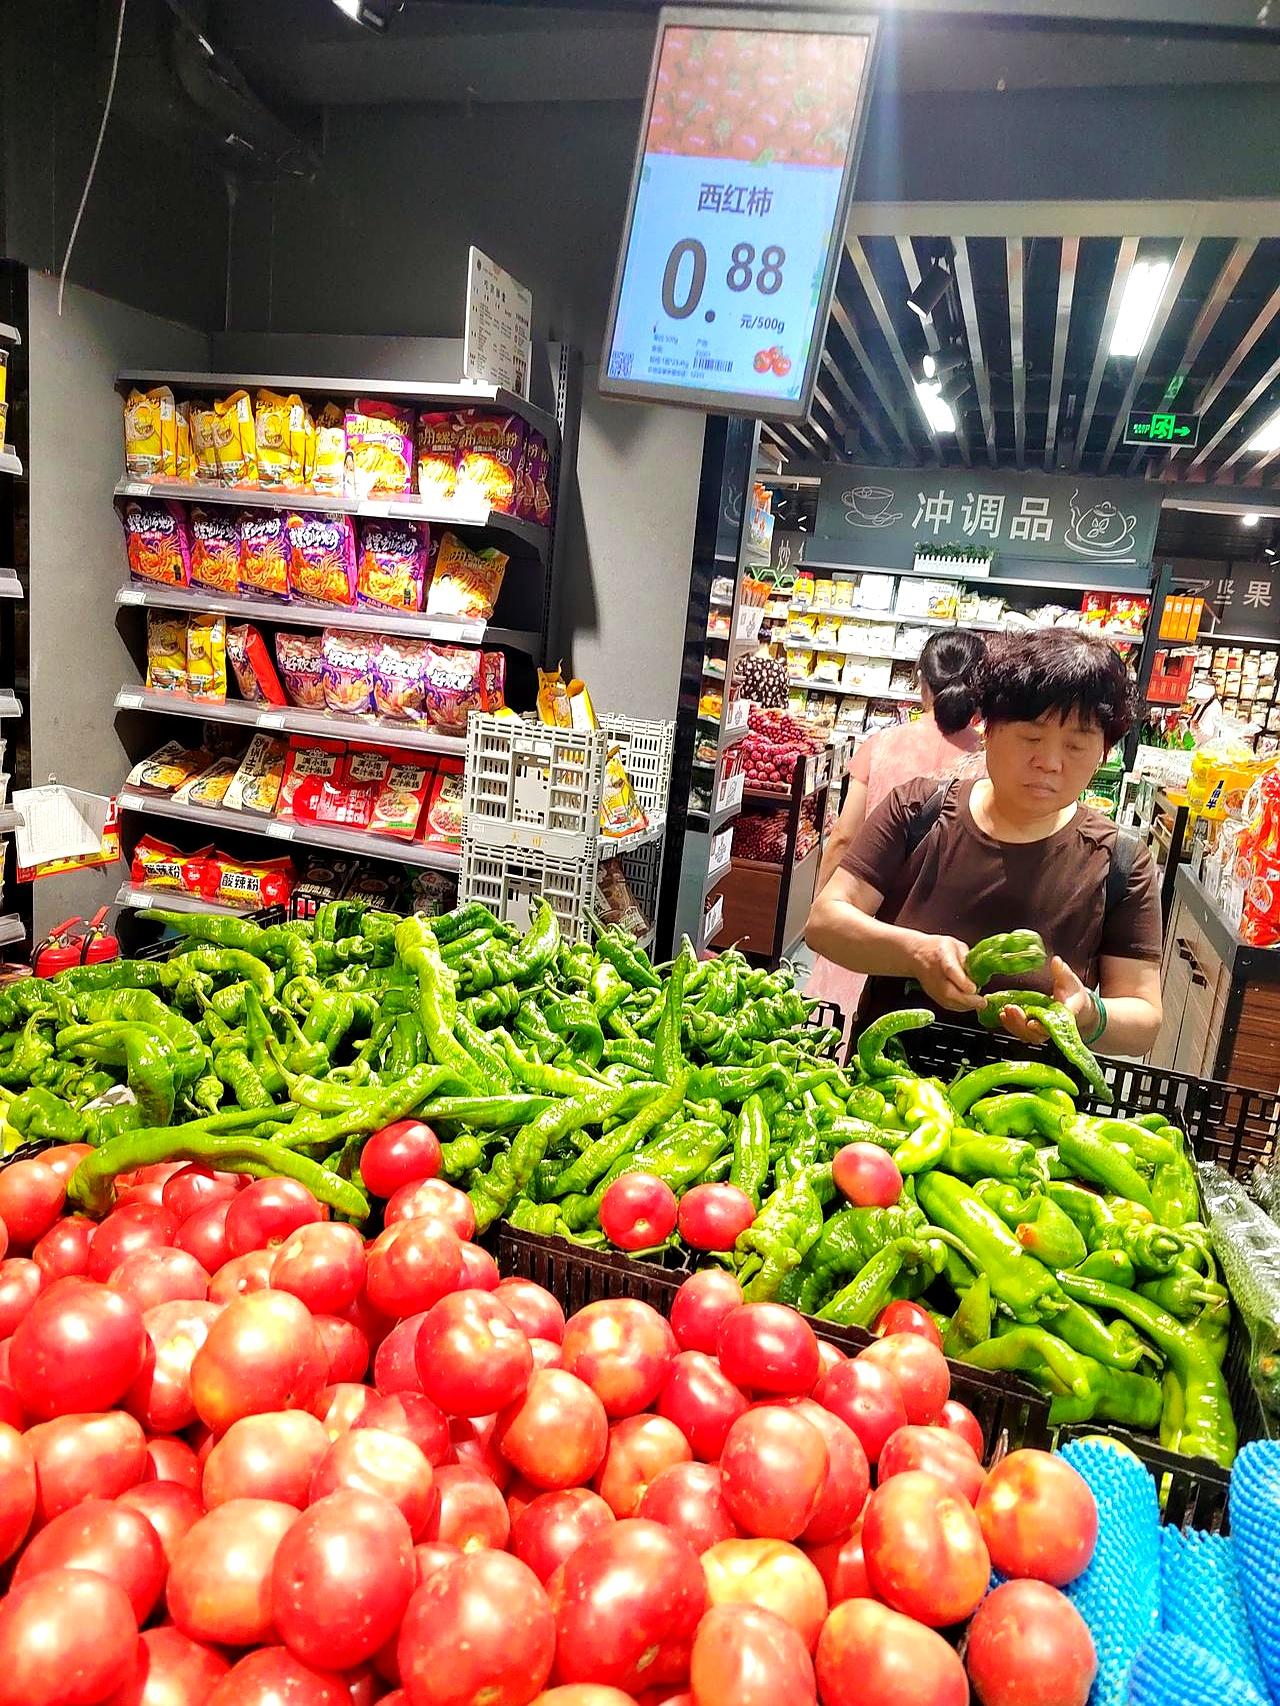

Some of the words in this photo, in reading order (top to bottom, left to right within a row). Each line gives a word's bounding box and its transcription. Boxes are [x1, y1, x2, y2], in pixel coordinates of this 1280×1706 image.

[697, 182, 774, 217] 西红柿
[739, 313, 785, 334] 元/500g
[912, 490, 1054, 542] 冲调品
[1213, 579, 1272, 608] 坚果
[222, 873, 259, 891] 酸辣粉
